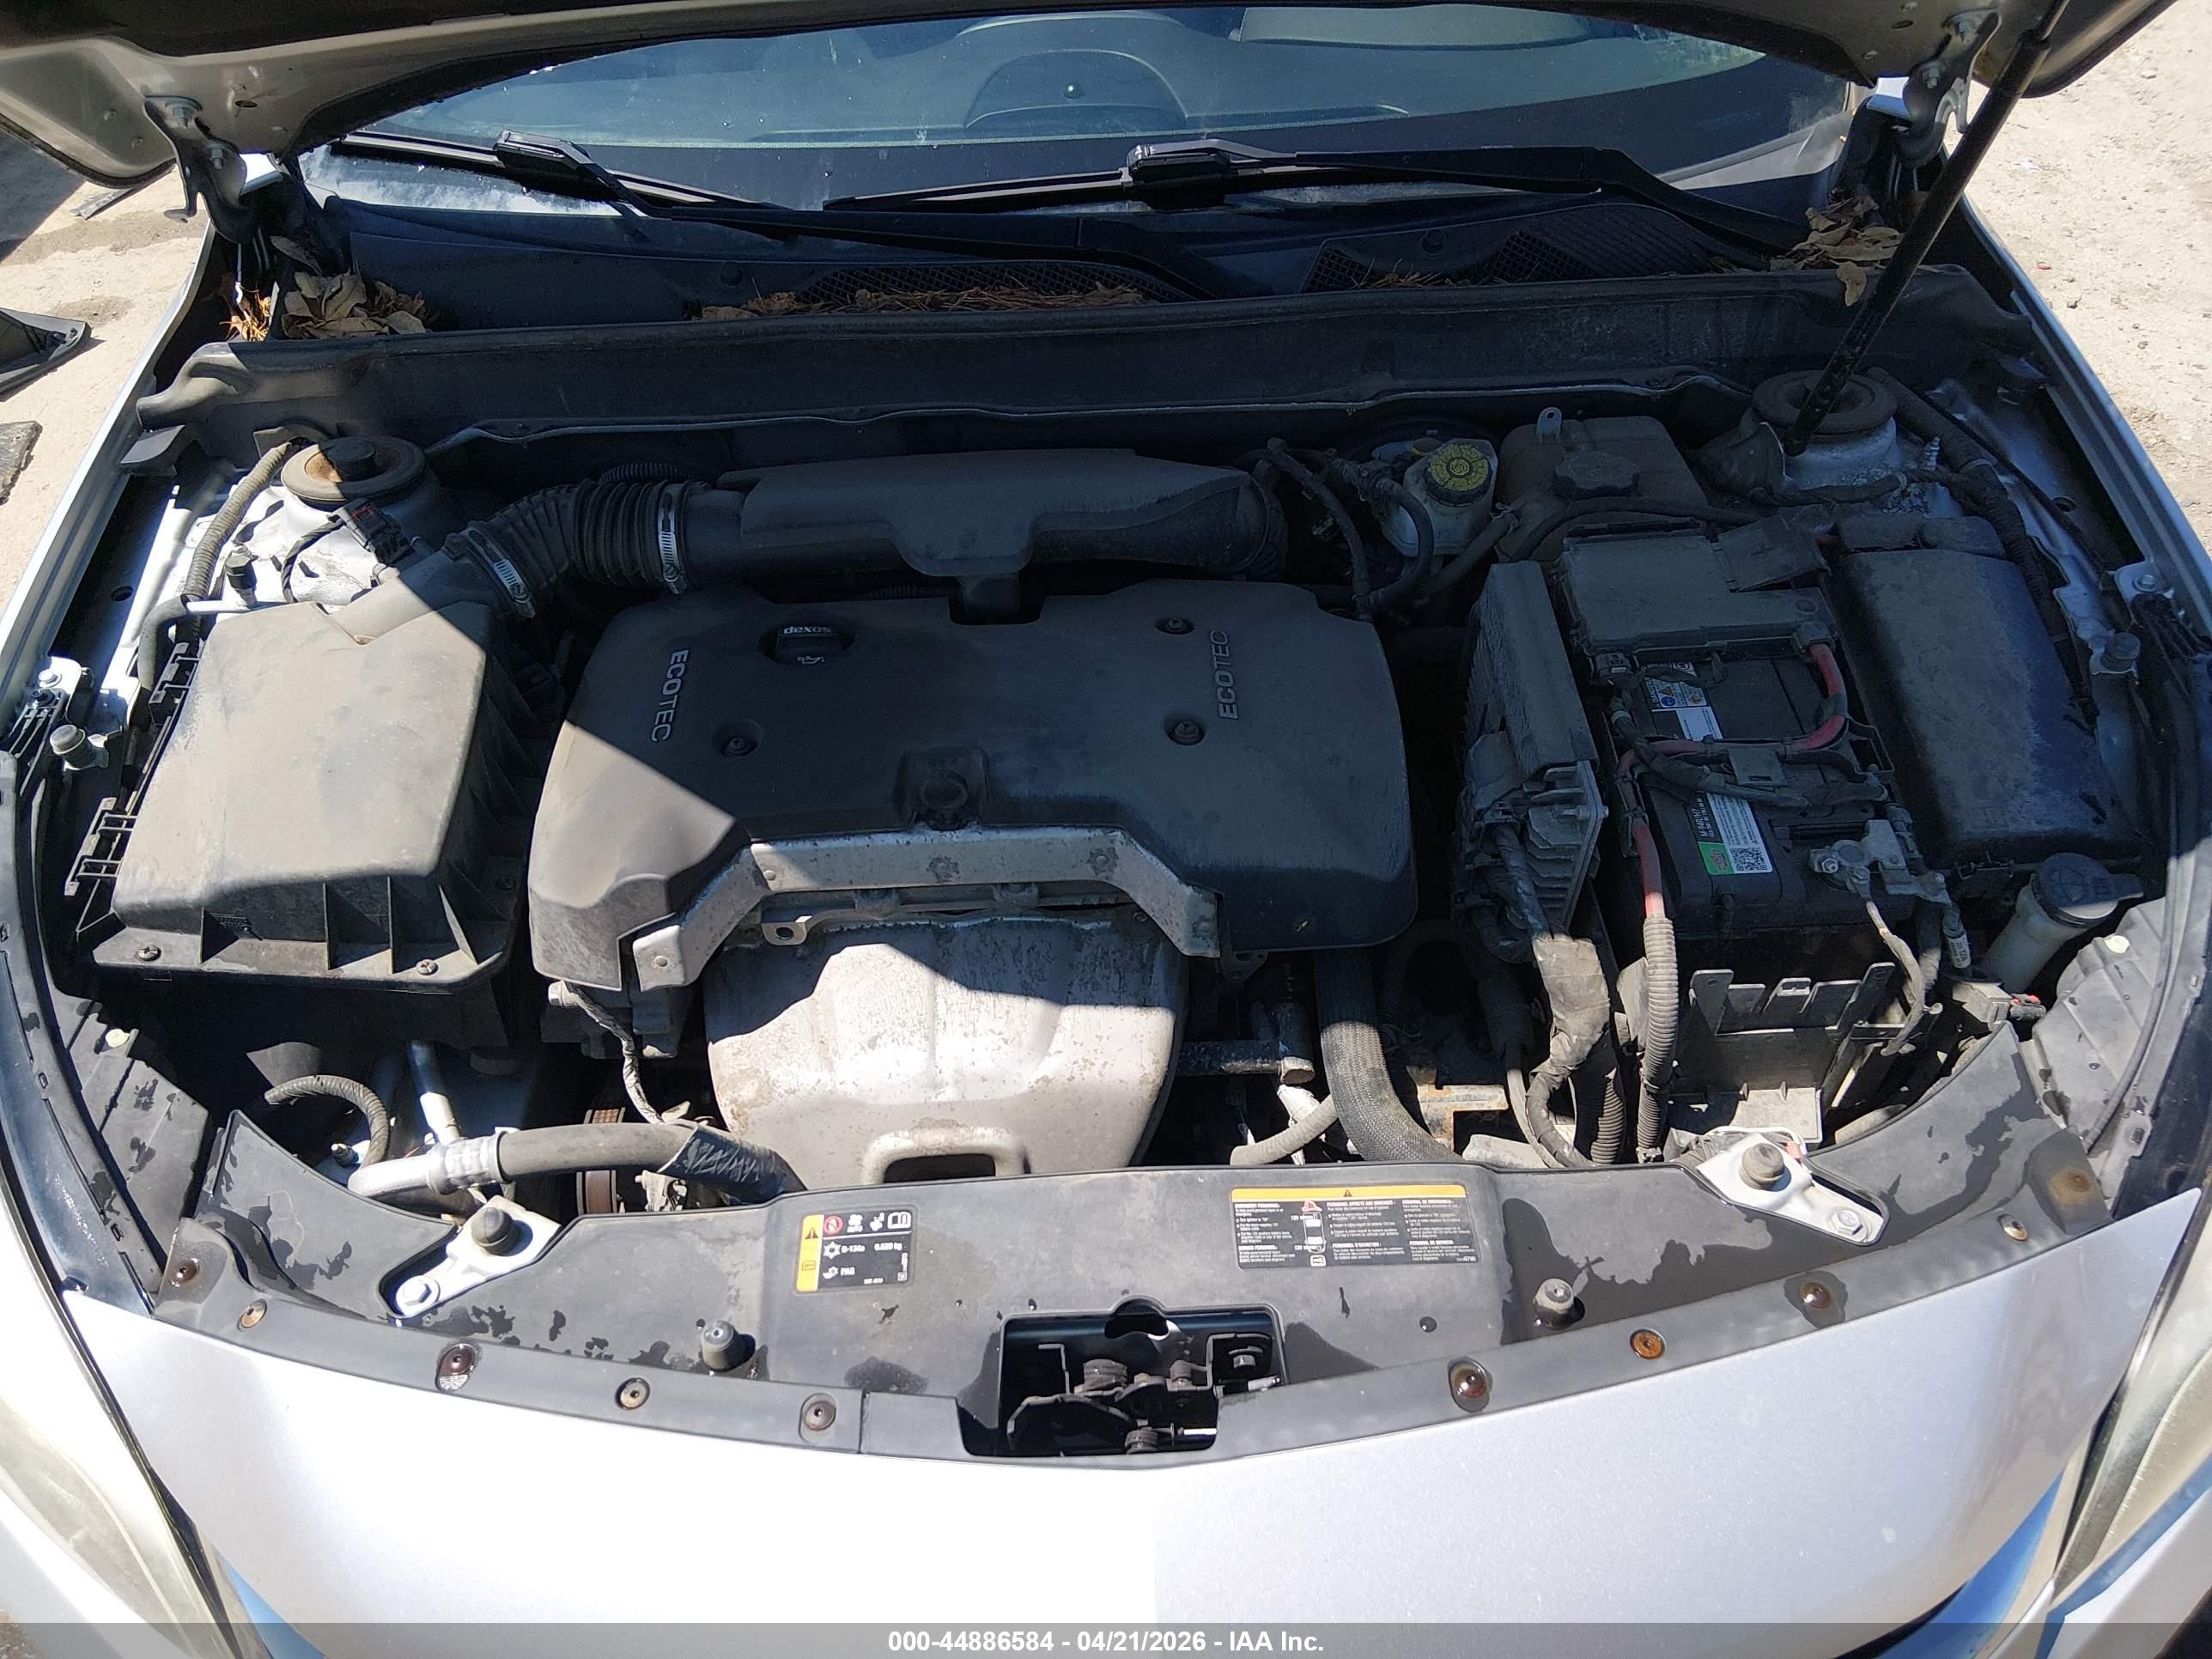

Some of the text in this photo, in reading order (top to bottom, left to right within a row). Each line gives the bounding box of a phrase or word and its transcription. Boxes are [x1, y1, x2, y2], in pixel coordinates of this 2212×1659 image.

[783, 625, 832, 635] dexos
[1210, 630, 1239, 720] ECOTEC
[650, 648, 690, 743] ECOTEC
